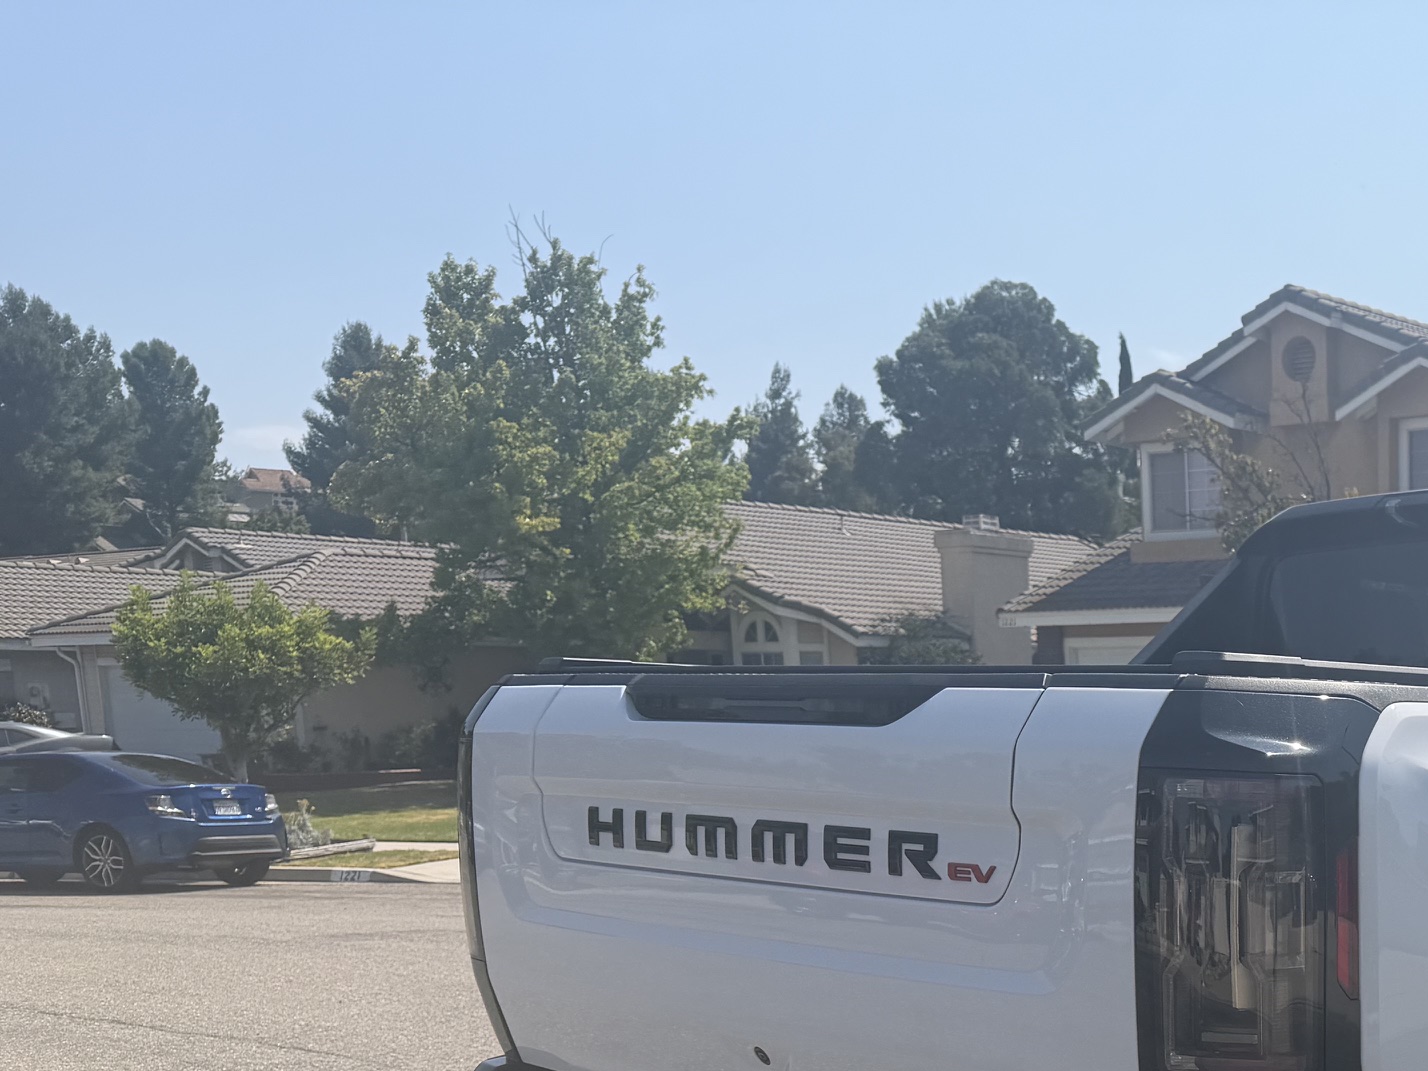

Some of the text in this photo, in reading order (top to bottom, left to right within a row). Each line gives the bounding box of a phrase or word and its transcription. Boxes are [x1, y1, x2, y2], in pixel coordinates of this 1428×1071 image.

[587, 805, 997, 884] HUMMER EV
[340, 870, 361, 881] 1221
